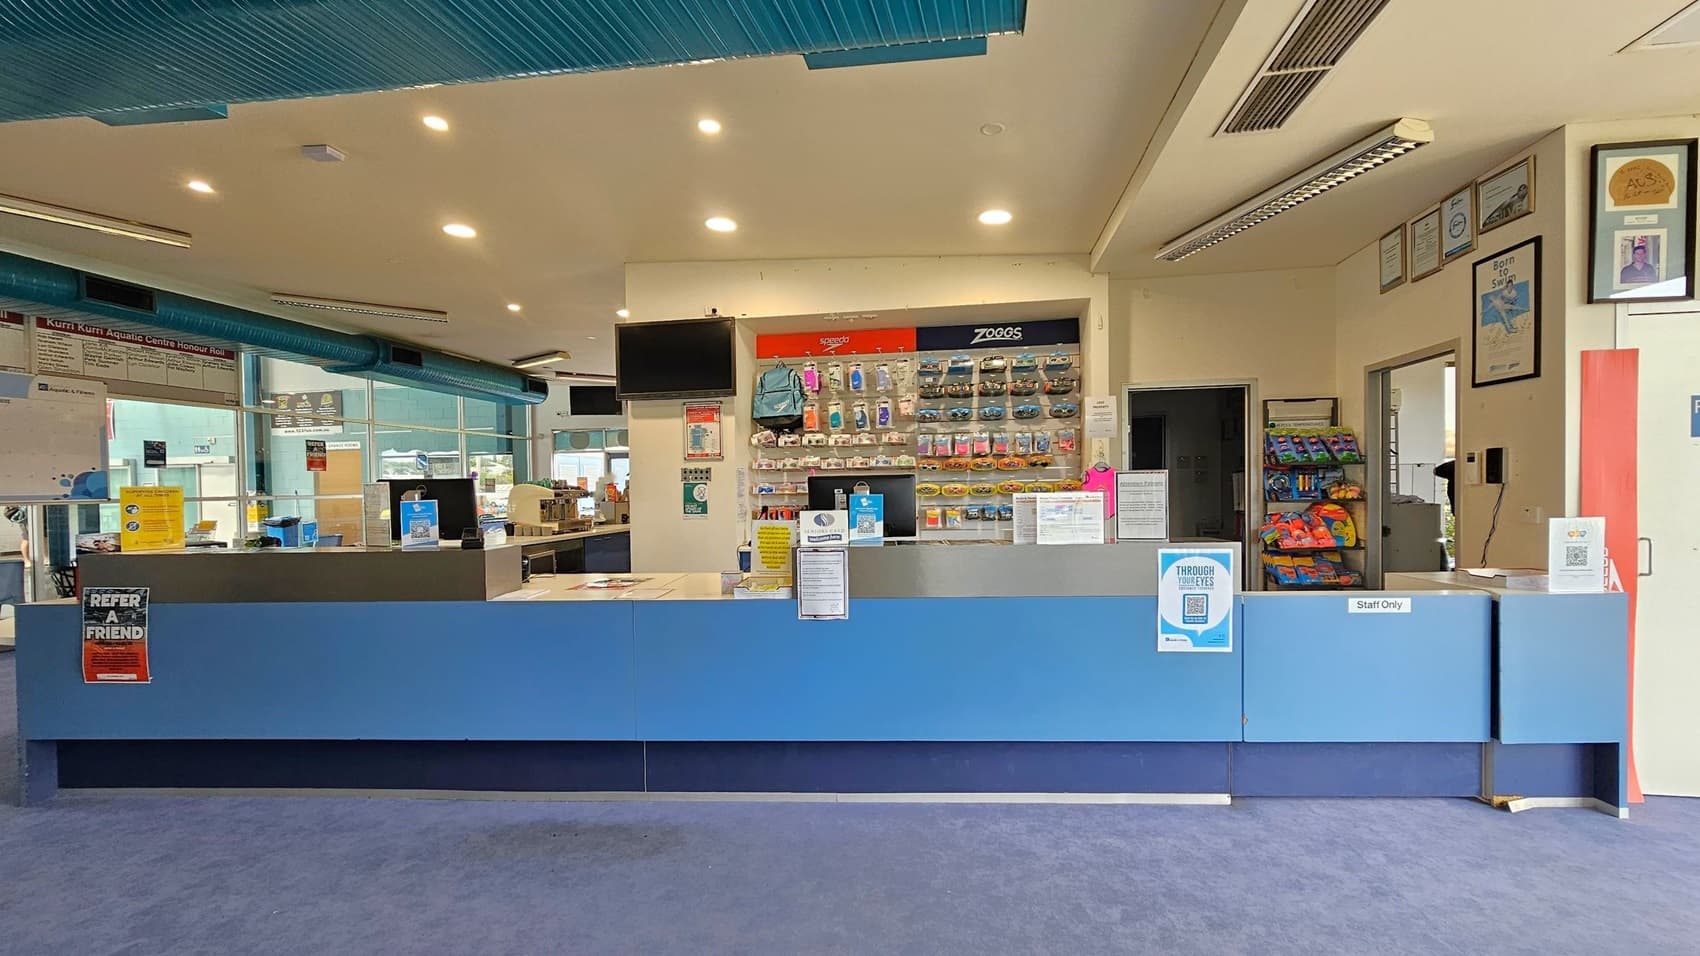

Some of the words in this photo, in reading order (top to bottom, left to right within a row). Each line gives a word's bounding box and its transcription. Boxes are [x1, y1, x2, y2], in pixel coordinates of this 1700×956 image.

[1493, 255, 1515, 271] Born
[1499, 268, 1509, 277] to
[1492, 273, 1517, 289] Swim
[46, 318, 74, 331] Kurri
[78, 324, 103, 335] Kurri
[106, 329, 143, 342] Aquatic
[145, 336, 176, 347] Centre
[177, 341, 208, 353] Honour
[210, 346, 225, 356] Roll
[820, 335, 849, 345] speedo
[970, 327, 1022, 344] ZOGGS
[1176, 565, 1215, 576] THROUGH
[1178, 576, 1195, 585] YOUR
[1195, 576, 1215, 587] EYES
[90, 593, 141, 607] REFER
[1356, 600, 1380, 609] Staff
[1381, 600, 1403, 610] Only
[105, 609, 119, 624] A
[86, 626, 144, 640] FRIEND
